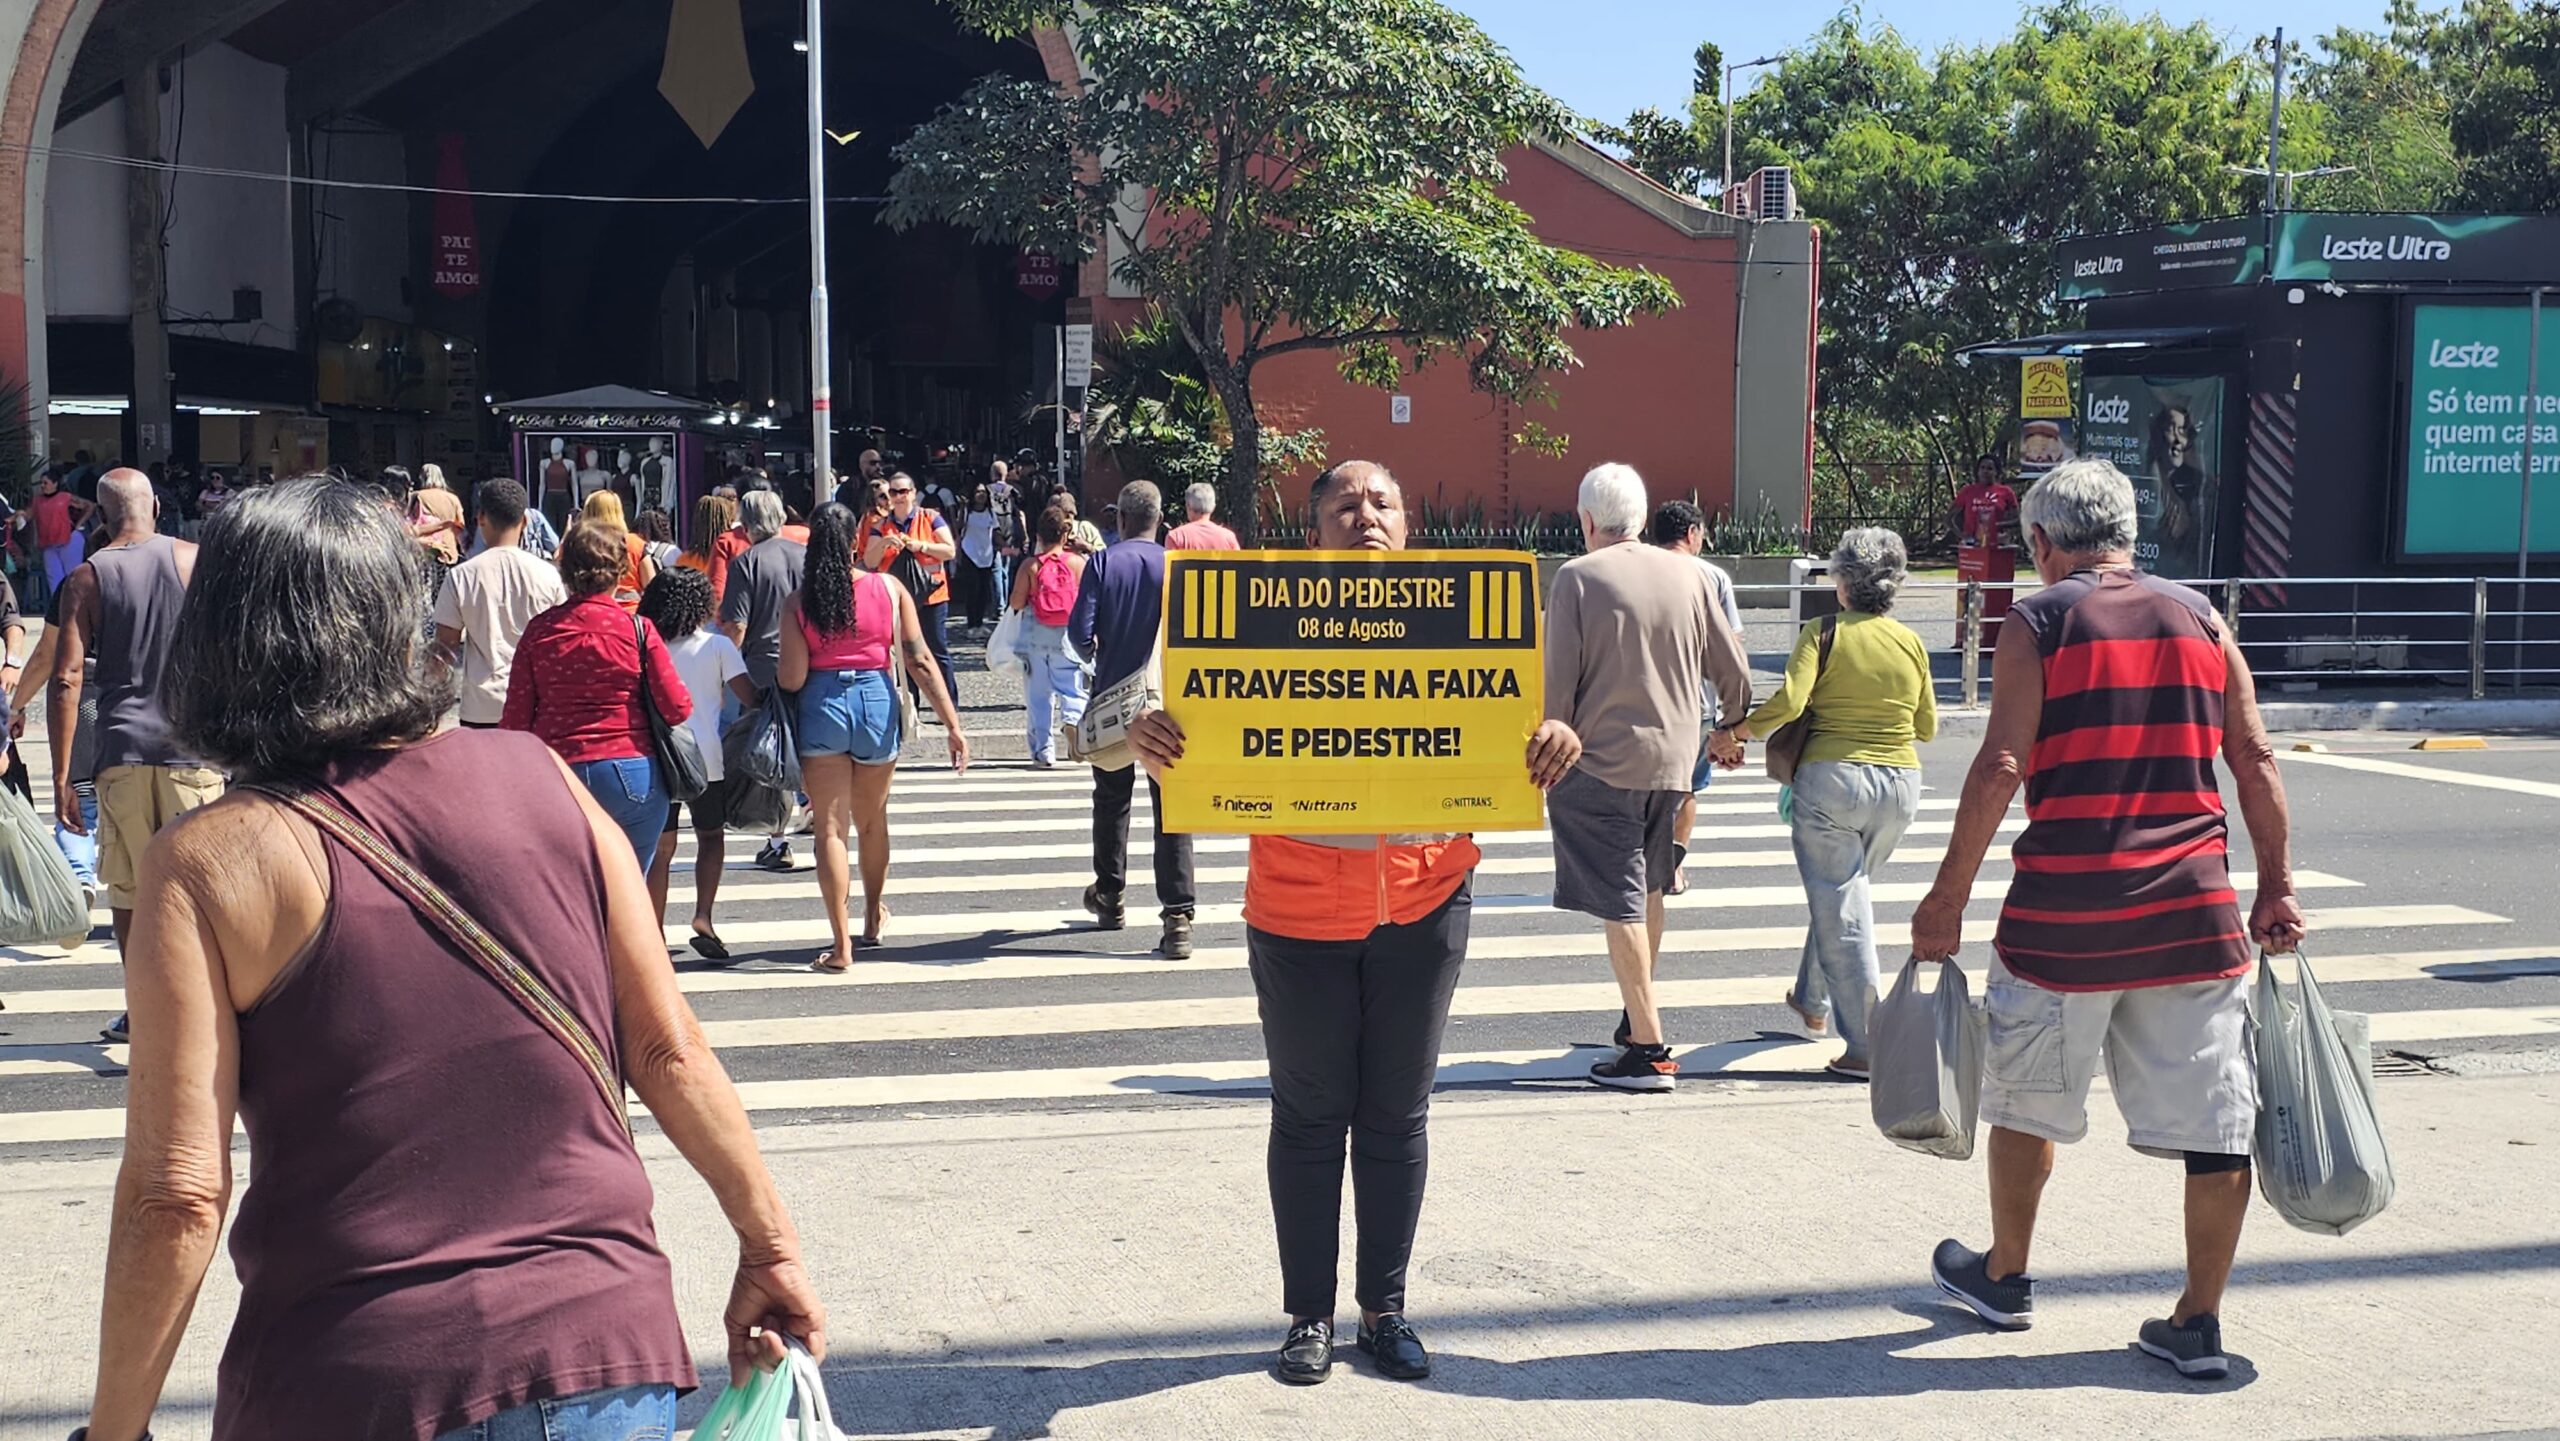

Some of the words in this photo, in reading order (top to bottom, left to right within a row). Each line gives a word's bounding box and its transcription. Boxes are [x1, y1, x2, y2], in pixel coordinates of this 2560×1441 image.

[2183, 240, 2211, 252] INTERNET
[2212, 239, 2221, 249] DO
[2387, 235, 2451, 260] Ultra
[444, 254, 468, 265] TE
[1030, 256, 1050, 267] TE
[2099, 256, 2123, 274] Ultra
[1019, 274, 1059, 286] AMO!
[2027, 396, 2067, 407] NATURAL
[2427, 386, 2459, 414] Só
[2464, 390, 2512, 414] tem
[2425, 424, 2496, 450] quem
[2501, 424, 2559, 444] casa
[2423, 449, 2522, 474] internet
[1249, 577, 1292, 609] DIA
[1298, 577, 1332, 608] DO
[1339, 577, 1456, 609] PEDESTRE
[1298, 617, 1319, 639] 08
[1323, 617, 1344, 639] de
[1348, 617, 1406, 643] Agosto
[1182, 668, 1366, 699] ATRAVESSE
[1374, 668, 1420, 699] NA
[1427, 668, 1521, 699] FAIXA
[1242, 728, 1284, 757] DE
[1291, 727, 1462, 758] PEDESTRE!
[1297, 800, 1358, 812] Nittrans
